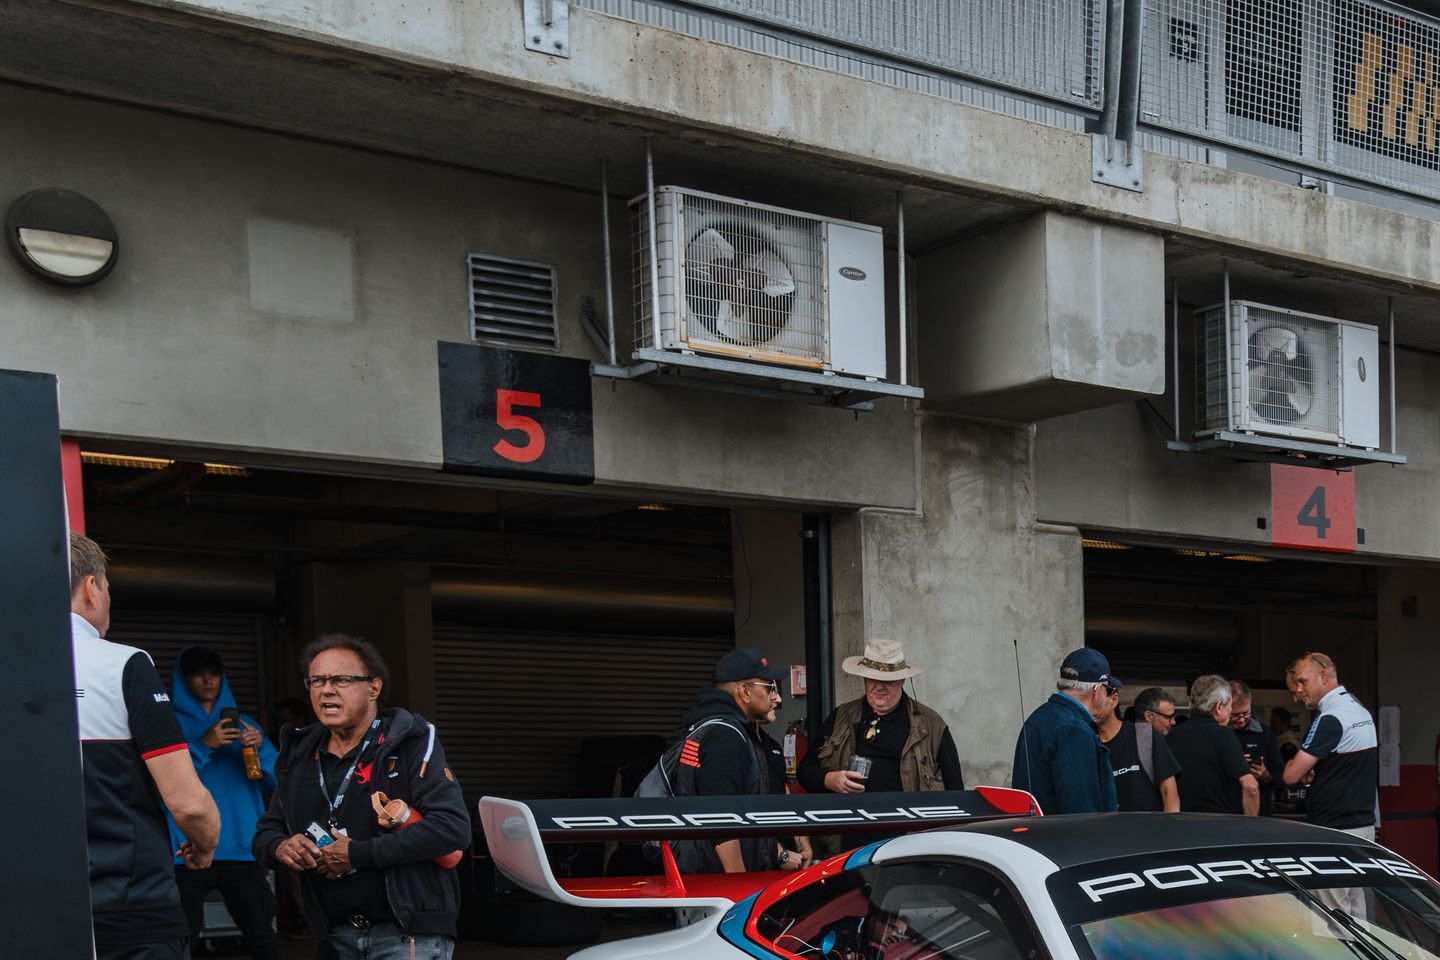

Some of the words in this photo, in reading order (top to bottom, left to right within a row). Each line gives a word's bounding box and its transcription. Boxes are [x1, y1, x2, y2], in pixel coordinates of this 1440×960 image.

[493, 389, 545, 463] 5
[1297, 486, 1331, 539] 4
[551, 805, 972, 829] PORSCHE
[1078, 856, 1428, 903] PORSCHE
